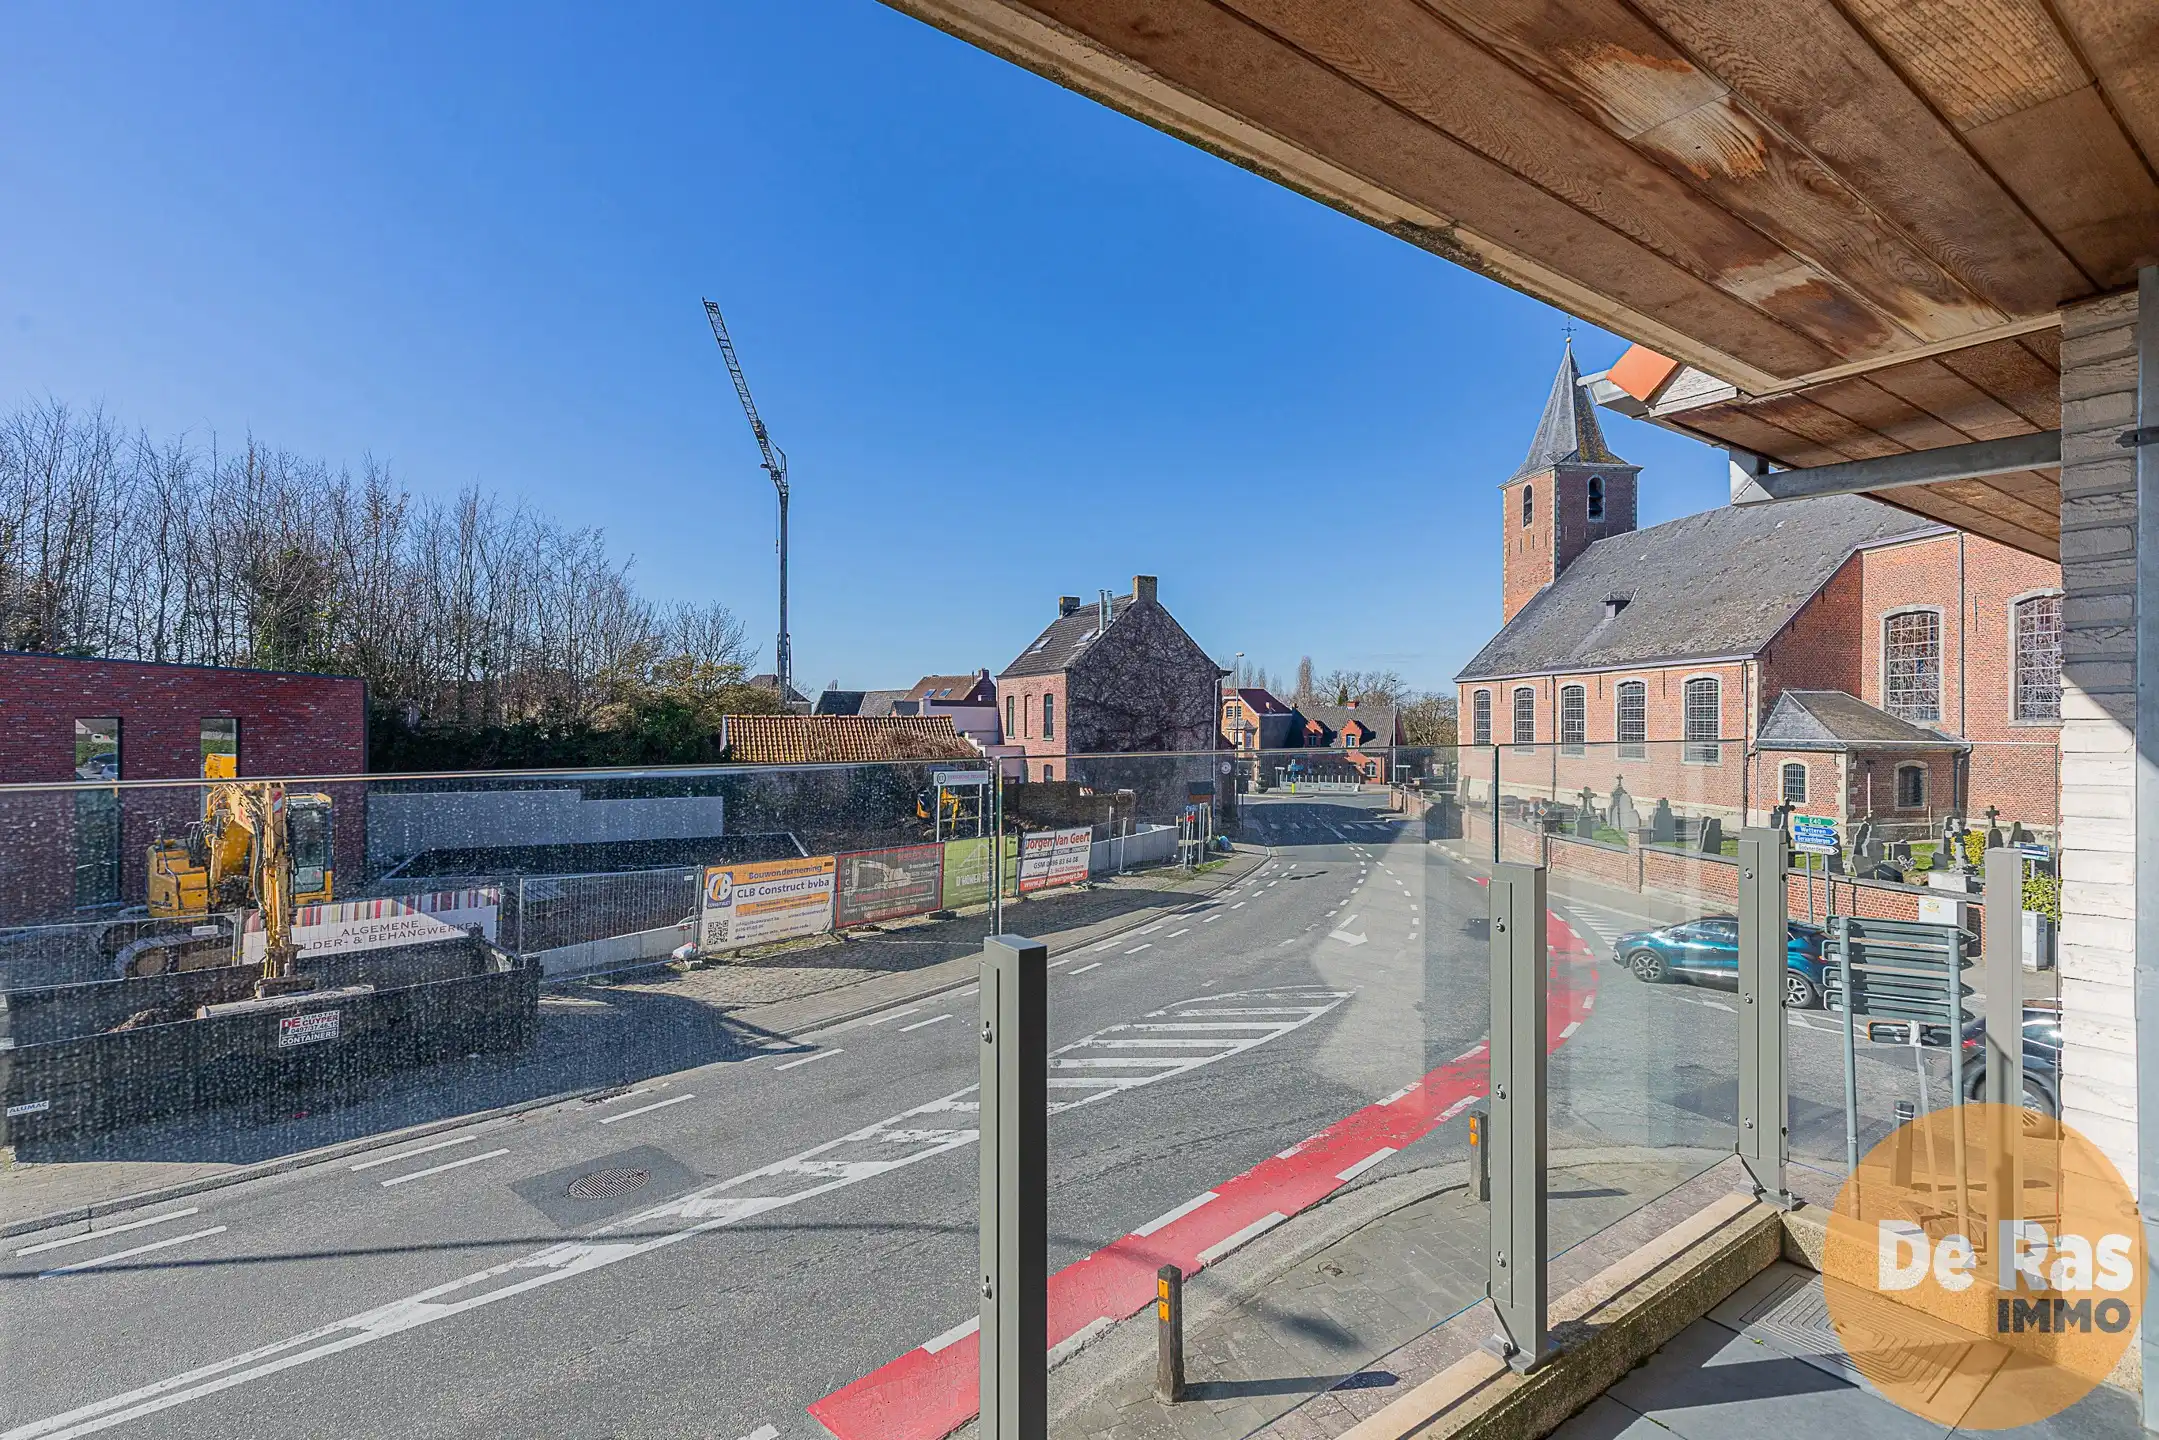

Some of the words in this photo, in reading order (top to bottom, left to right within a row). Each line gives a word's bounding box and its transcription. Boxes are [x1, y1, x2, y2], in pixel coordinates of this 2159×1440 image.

[1800, 826, 1827, 834] Wetteren
[1025, 838, 1053, 851] Jorgen
[1055, 834, 1069, 846] Van
[1070, 831, 1090, 844] Geert
[748, 865, 823, 880] Bouwonderneming
[1033, 861, 1046, 869] GSM
[737, 887, 756, 899] CLB
[758, 881, 806, 896] Construct
[807, 878, 830, 889] bvba
[302, 938, 349, 951] LDER-
[353, 936, 363, 945] &
[368, 920, 483, 943] BEHANGWERKEN
[341, 919, 420, 937] ALGEMENE
[281, 1017, 302, 1028] DE
[302, 1014, 339, 1026] CUYPER
[303, 1010, 339, 1019] TIMOTHY
[281, 1030, 337, 1046] CONTAINERS
[9, 1101, 47, 1113] ALUMAC
